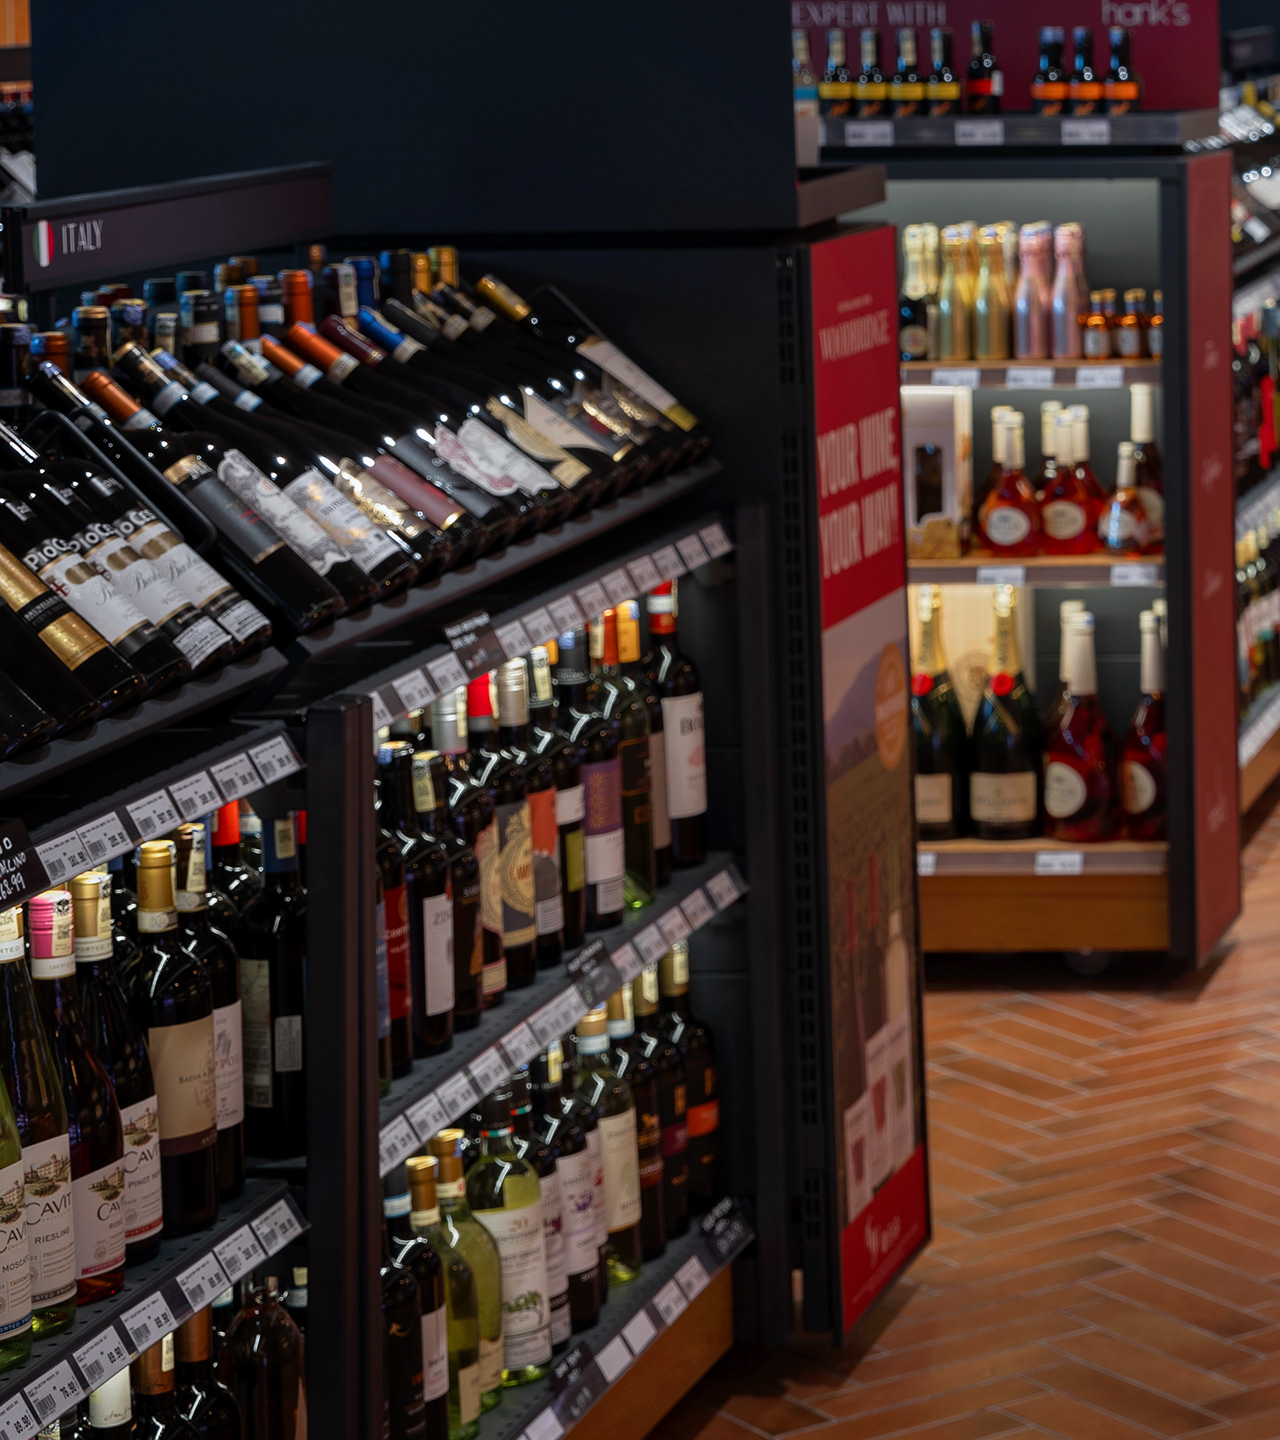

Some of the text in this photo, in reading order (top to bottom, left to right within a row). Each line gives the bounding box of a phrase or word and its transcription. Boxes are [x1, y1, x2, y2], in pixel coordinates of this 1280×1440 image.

[792, 0, 947, 28] EXPERT WITH
[61, 219, 104, 255] ITALY
[816, 422, 861, 500] YOUR
[819, 500, 864, 580] YOUR
[34, 1226, 71, 1245] RIESLING
[60, 1380, 78, 1400] 76.90
